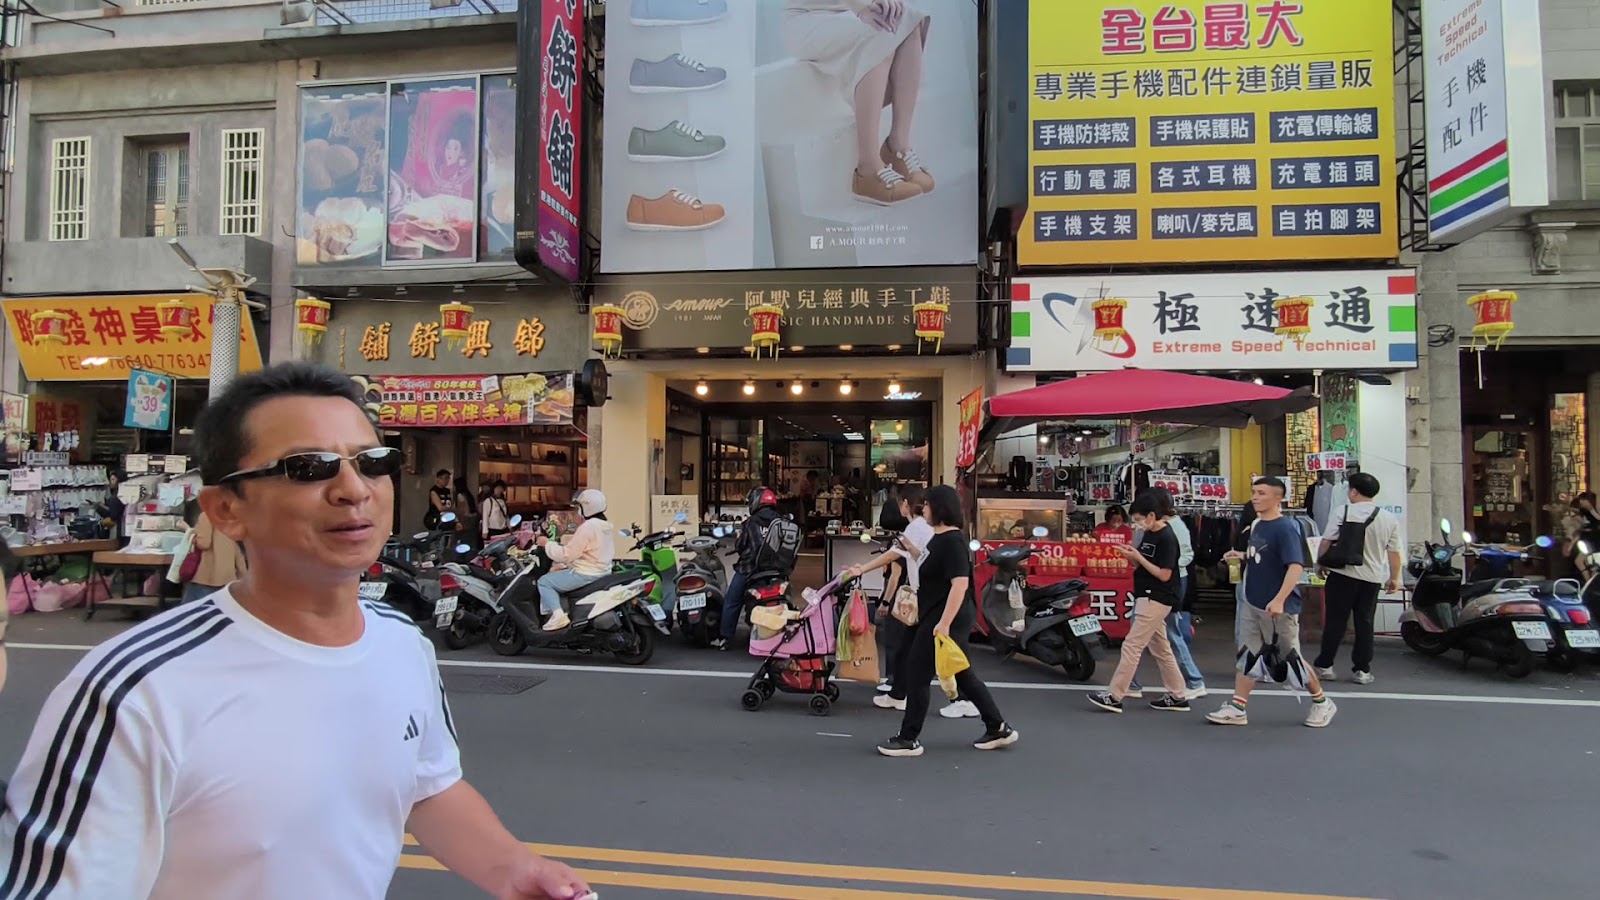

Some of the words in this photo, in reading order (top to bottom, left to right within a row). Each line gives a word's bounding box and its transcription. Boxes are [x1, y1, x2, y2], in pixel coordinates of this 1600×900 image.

[1101, 1, 1302, 54] 全台最大
[1440, 0, 1484, 36] Extreme
[1445, 14, 1477, 46] Speed
[1437, 20, 1488, 66] Technical
[1033, 59, 1373, 101] 專業手機配件連鎖量販
[1442, 57, 1487, 108] 手機
[1039, 122, 1131, 146] 手機防摔殼
[1156, 118, 1250, 141] 手機保護貼
[1277, 113, 1374, 137] 充電傳輸線
[1443, 102, 1488, 153] 配件
[1040, 168, 1132, 192] 行動電源
[1158, 164, 1252, 188] 各式耳機
[1278, 160, 1376, 185] 充電插頭
[825, 224, 908, 232] www.amour1981.com
[1039, 214, 1132, 237] 手機支架
[1157, 212, 1254, 235] 喇叭/麥克風
[1279, 208, 1376, 232] 自拍腳架
[829, 237, 866, 246] A.MOUR
[744, 287, 951, 312] 阿默兒經典手工鞋
[1153, 286, 1376, 335] 極速通
[743, 315, 804, 328] CSIC
[811, 314, 895, 326] HANDMADE
[1153, 341, 1222, 353] Extreme
[1231, 340, 1283, 354] Speed
[1295, 339, 1376, 352] Technical
[142, 395, 157, 412] 39
[379, 402, 521, 424] 台灣百大伴手禮
[1135, 443, 1145, 453] 98
[1307, 460, 1321, 470] 98
[1326, 458, 1344, 469] 198
[1093, 487, 1111, 499] 98
[1200, 483, 1227, 498] 98
[1041, 545, 1064, 558] 60
[1069, 545, 1122, 557] 全部每支6
